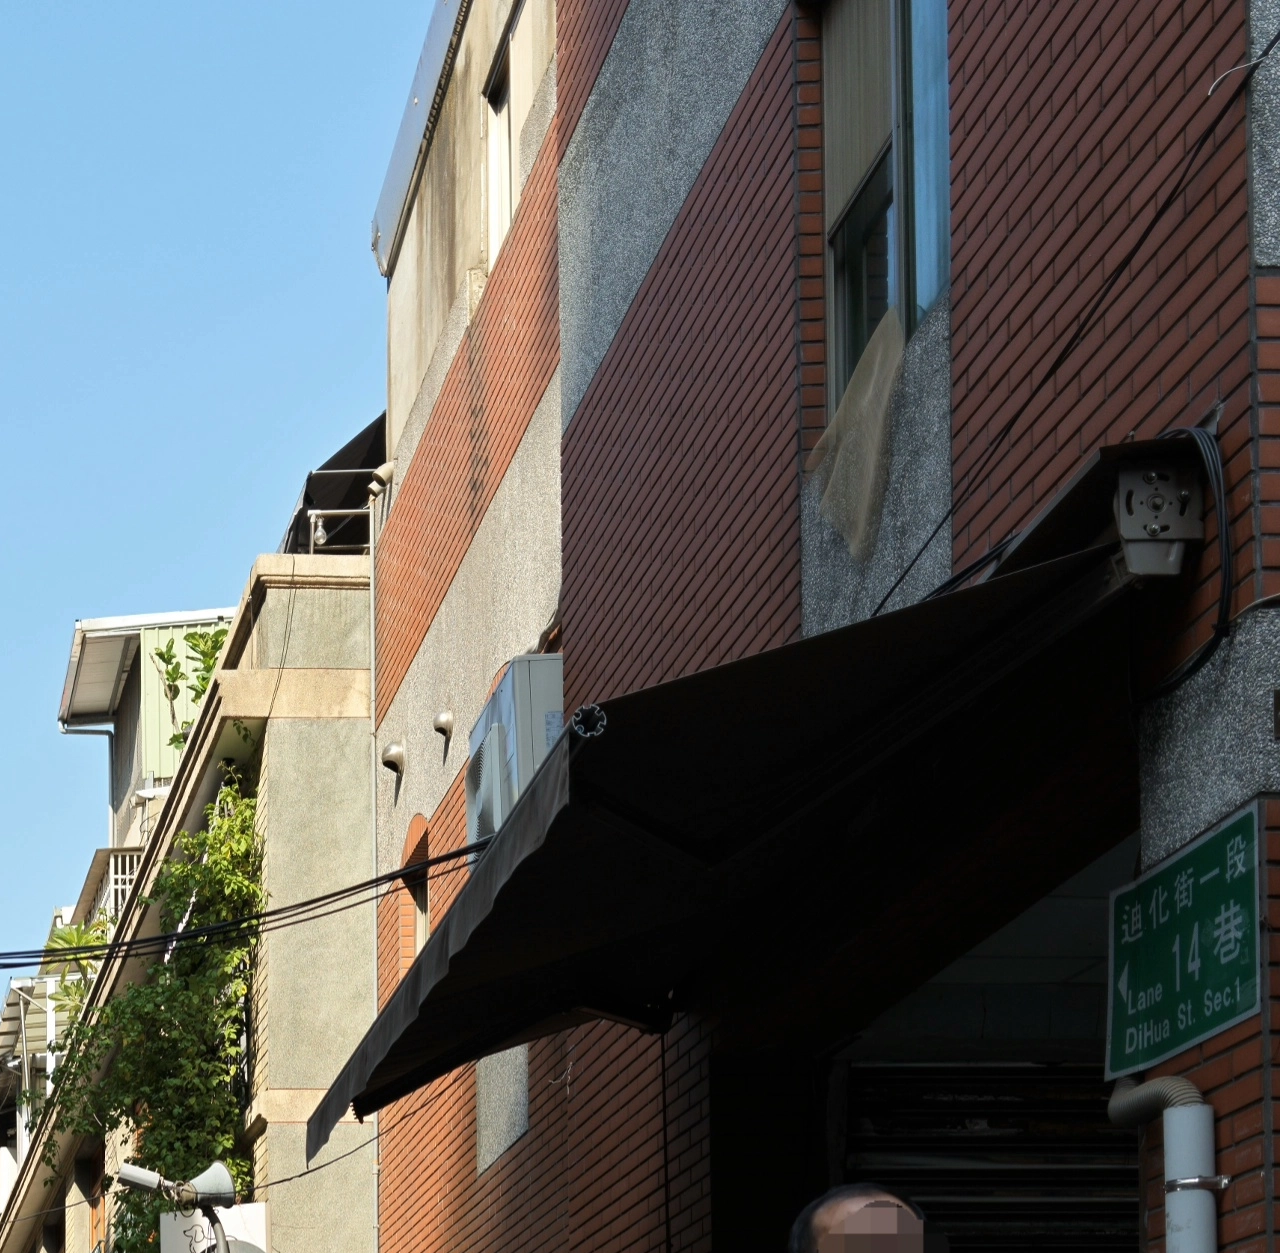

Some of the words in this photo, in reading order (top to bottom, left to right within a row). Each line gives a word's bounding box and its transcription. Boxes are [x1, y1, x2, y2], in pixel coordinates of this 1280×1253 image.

[1121, 836, 1247, 945] 迪化街一段
[1127, 982, 1163, 1015] Lane
[1125, 1018, 1170, 1055] DiHua
[1177, 1002, 1196, 1030] St.
